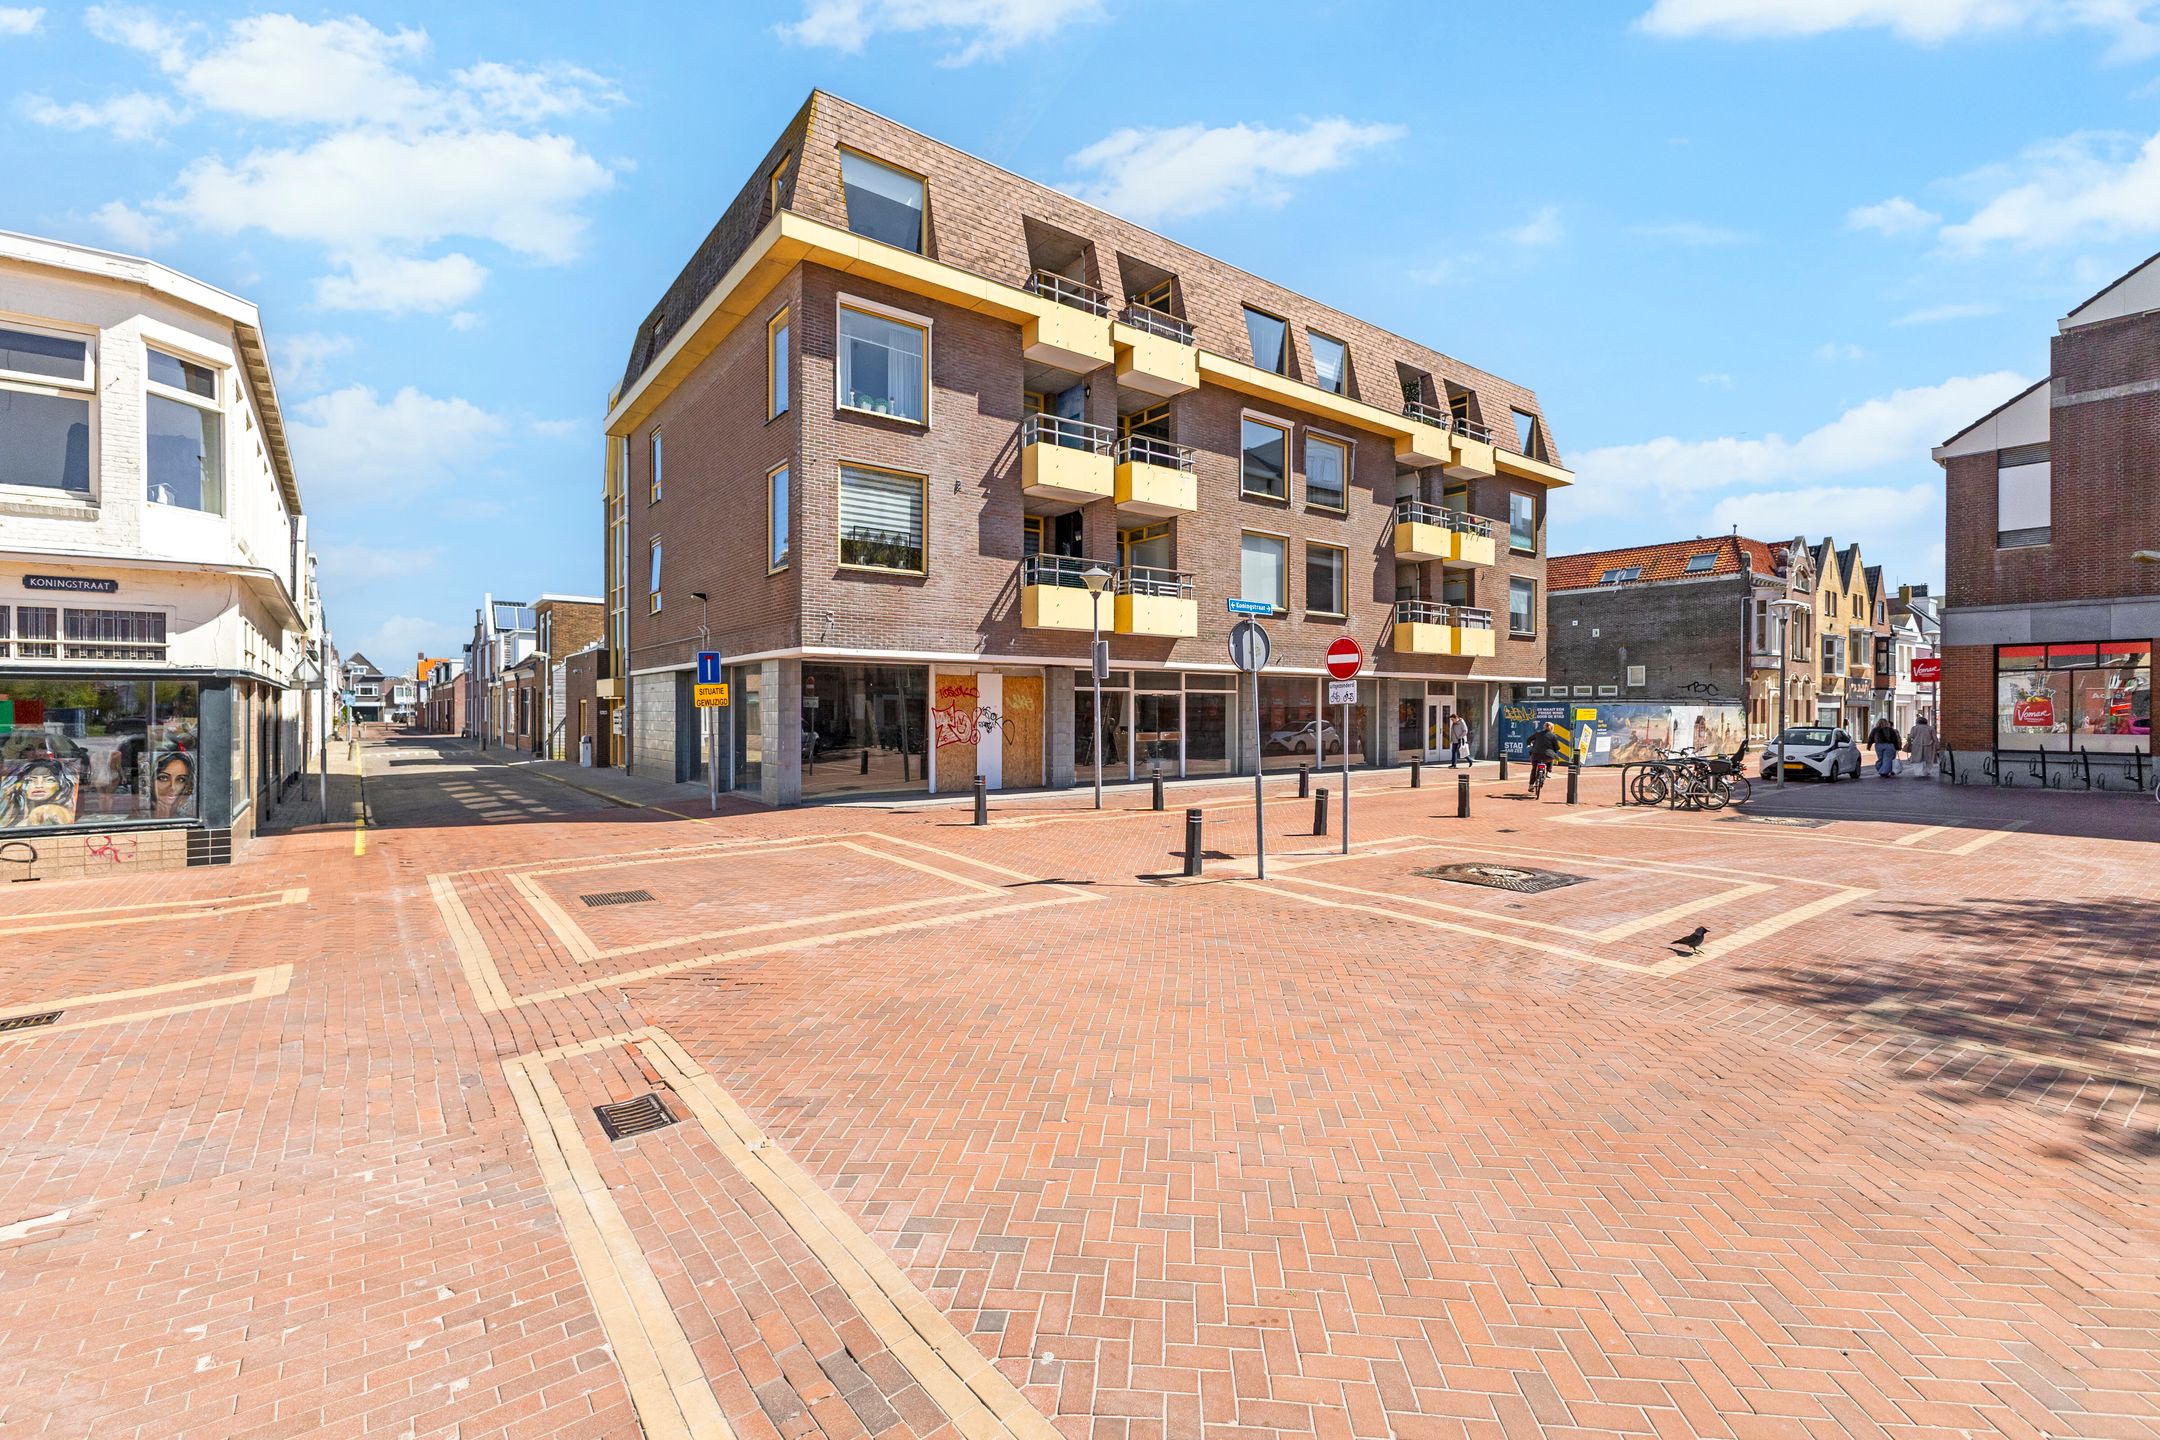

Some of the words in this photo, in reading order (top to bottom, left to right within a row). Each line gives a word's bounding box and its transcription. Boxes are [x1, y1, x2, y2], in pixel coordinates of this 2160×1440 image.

[30, 577, 110, 590] KONINGSTRAAT
[1235, 601, 1266, 611] Koningstraat
[1330, 682, 1355, 690] uitgezonderd
[698, 687, 724, 695] SITUATIE
[696, 698, 728, 706] GEWIJZIGD
[2017, 705, 2051, 720] Vomar
[1504, 741, 1524, 749] STAD
